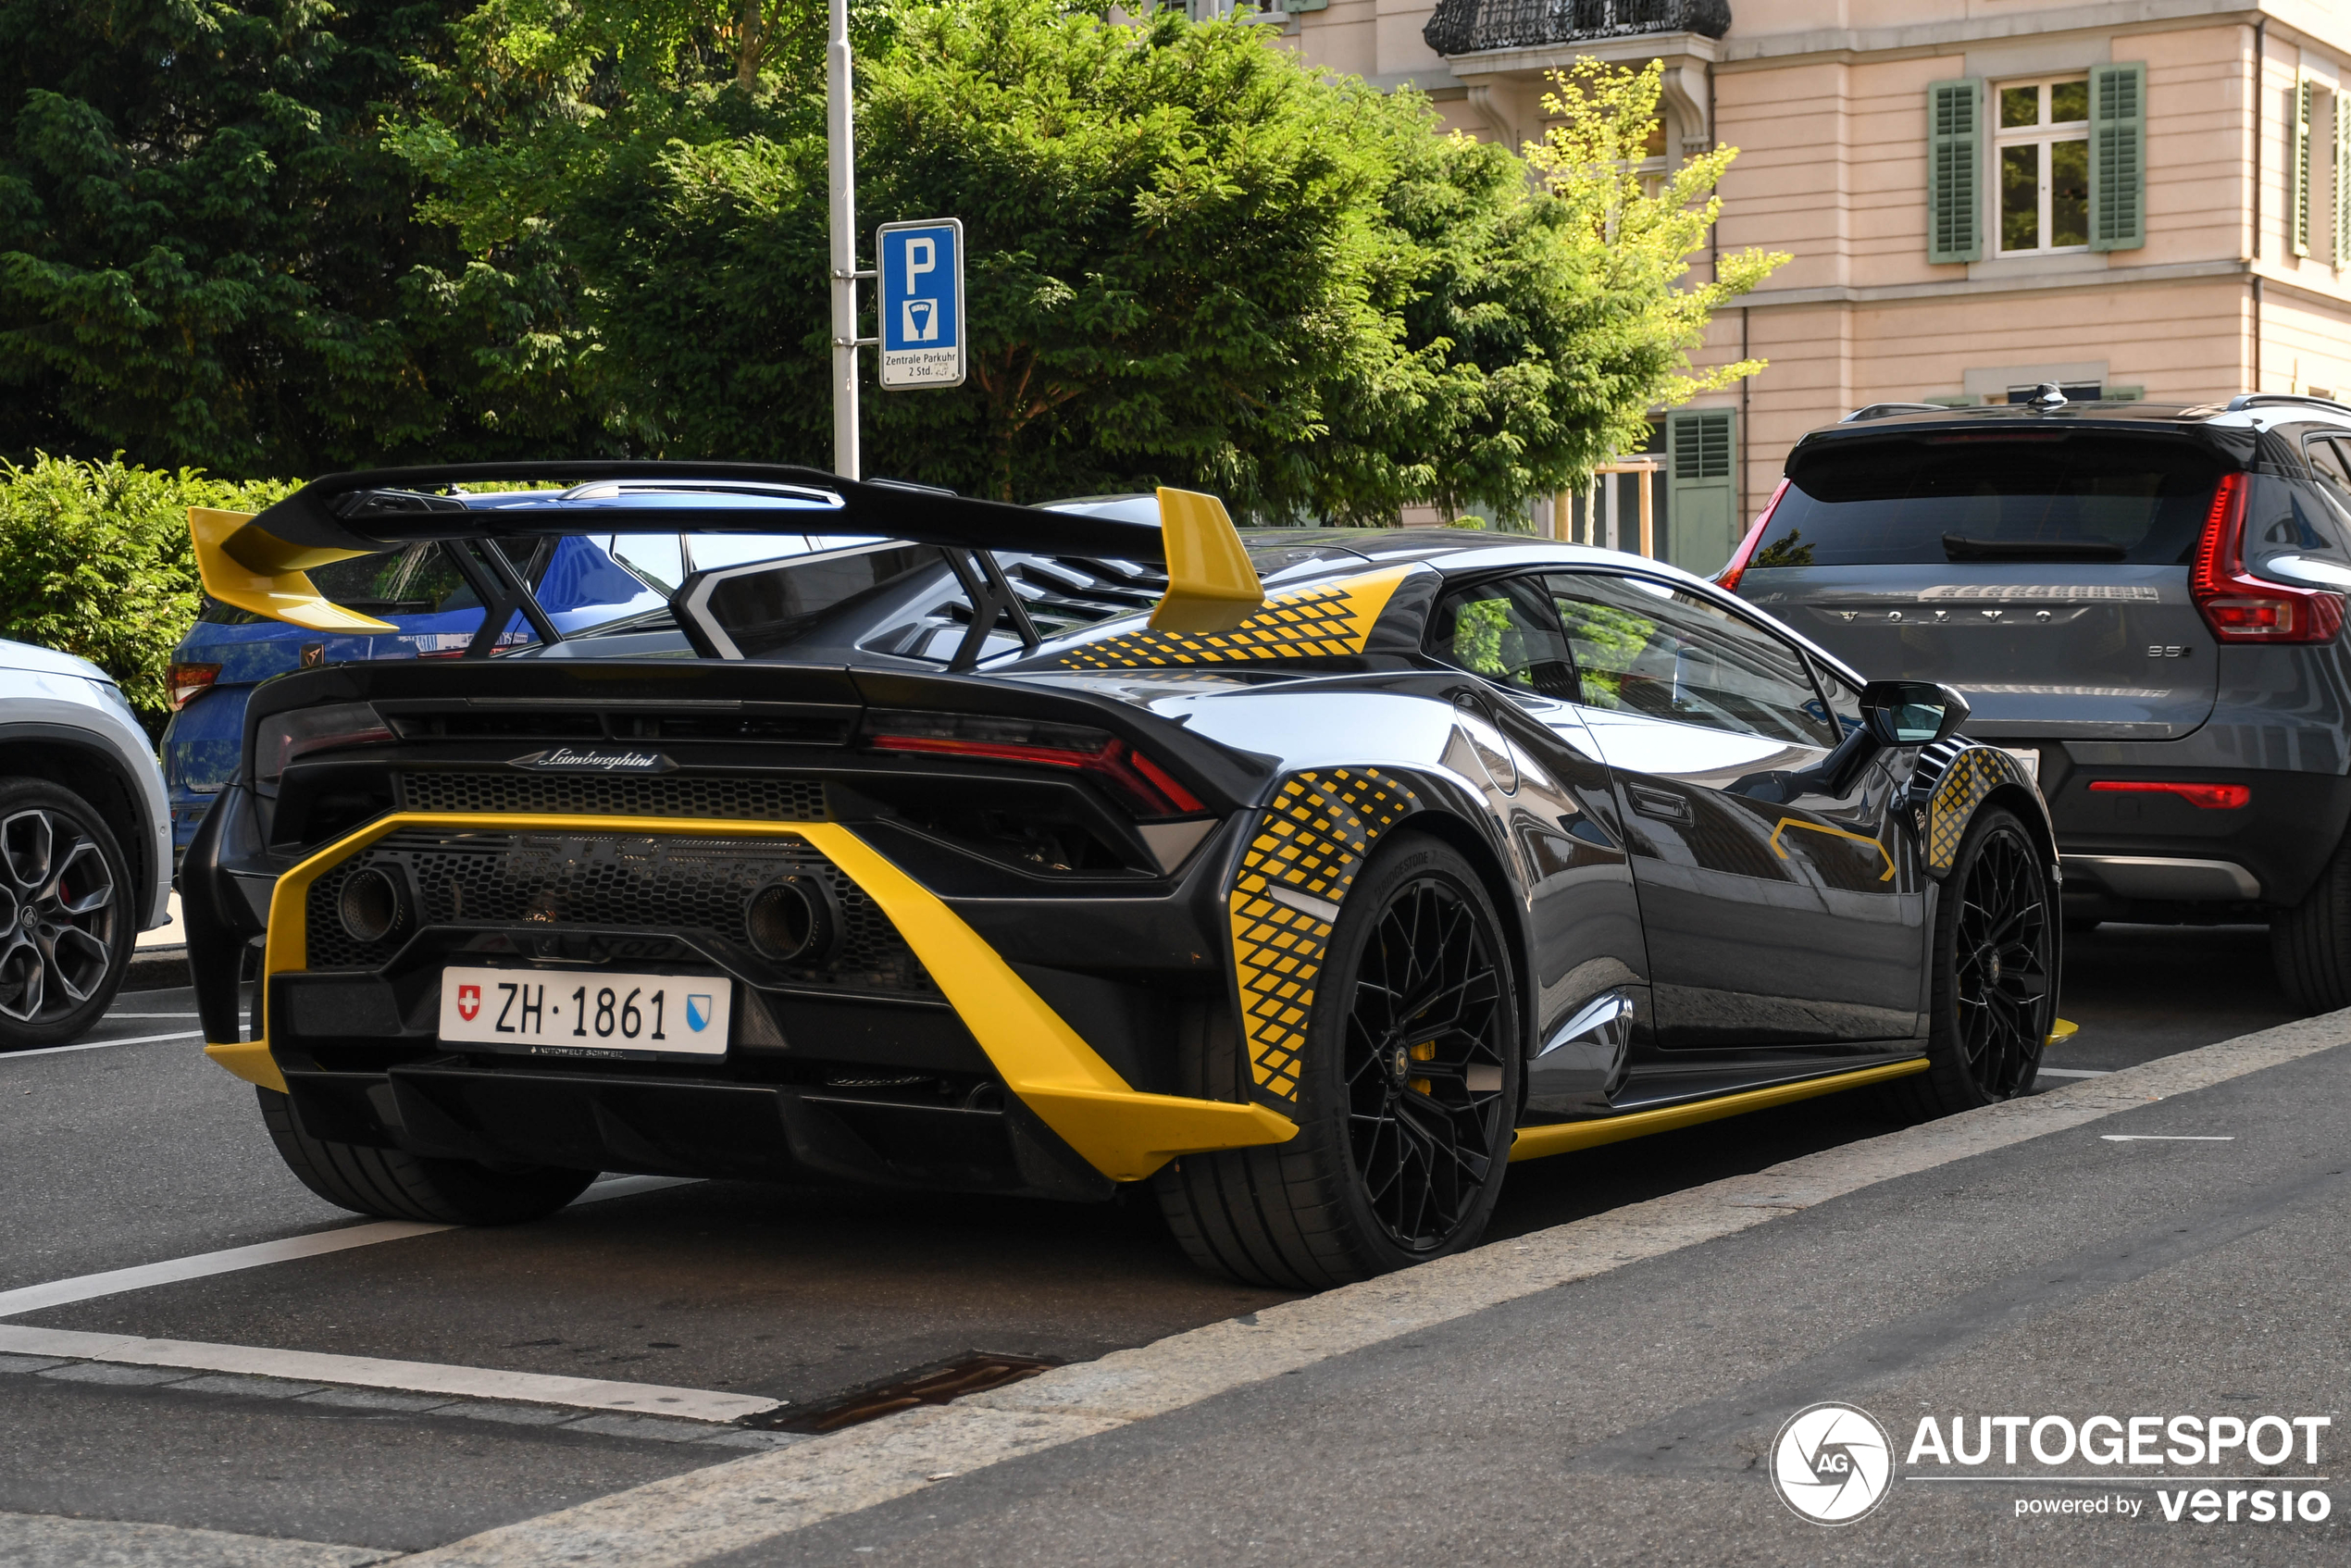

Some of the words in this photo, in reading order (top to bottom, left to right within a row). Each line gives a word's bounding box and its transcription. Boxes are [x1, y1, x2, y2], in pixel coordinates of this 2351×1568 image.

[905, 237, 936, 295] P
[886, 354, 921, 366] Zentrale
[924, 351, 956, 364] Parkuhr
[909, 367, 914, 377] 2
[916, 366, 933, 377] Std.
[1839, 609, 2052, 624] VOLVO
[538, 748, 658, 770] Lamborghini
[1375, 852, 1428, 904] BRIDGESTONE
[541, 1047, 584, 1056] AUTOWELT
[586, 1049, 624, 1058] SCHWEIZ
